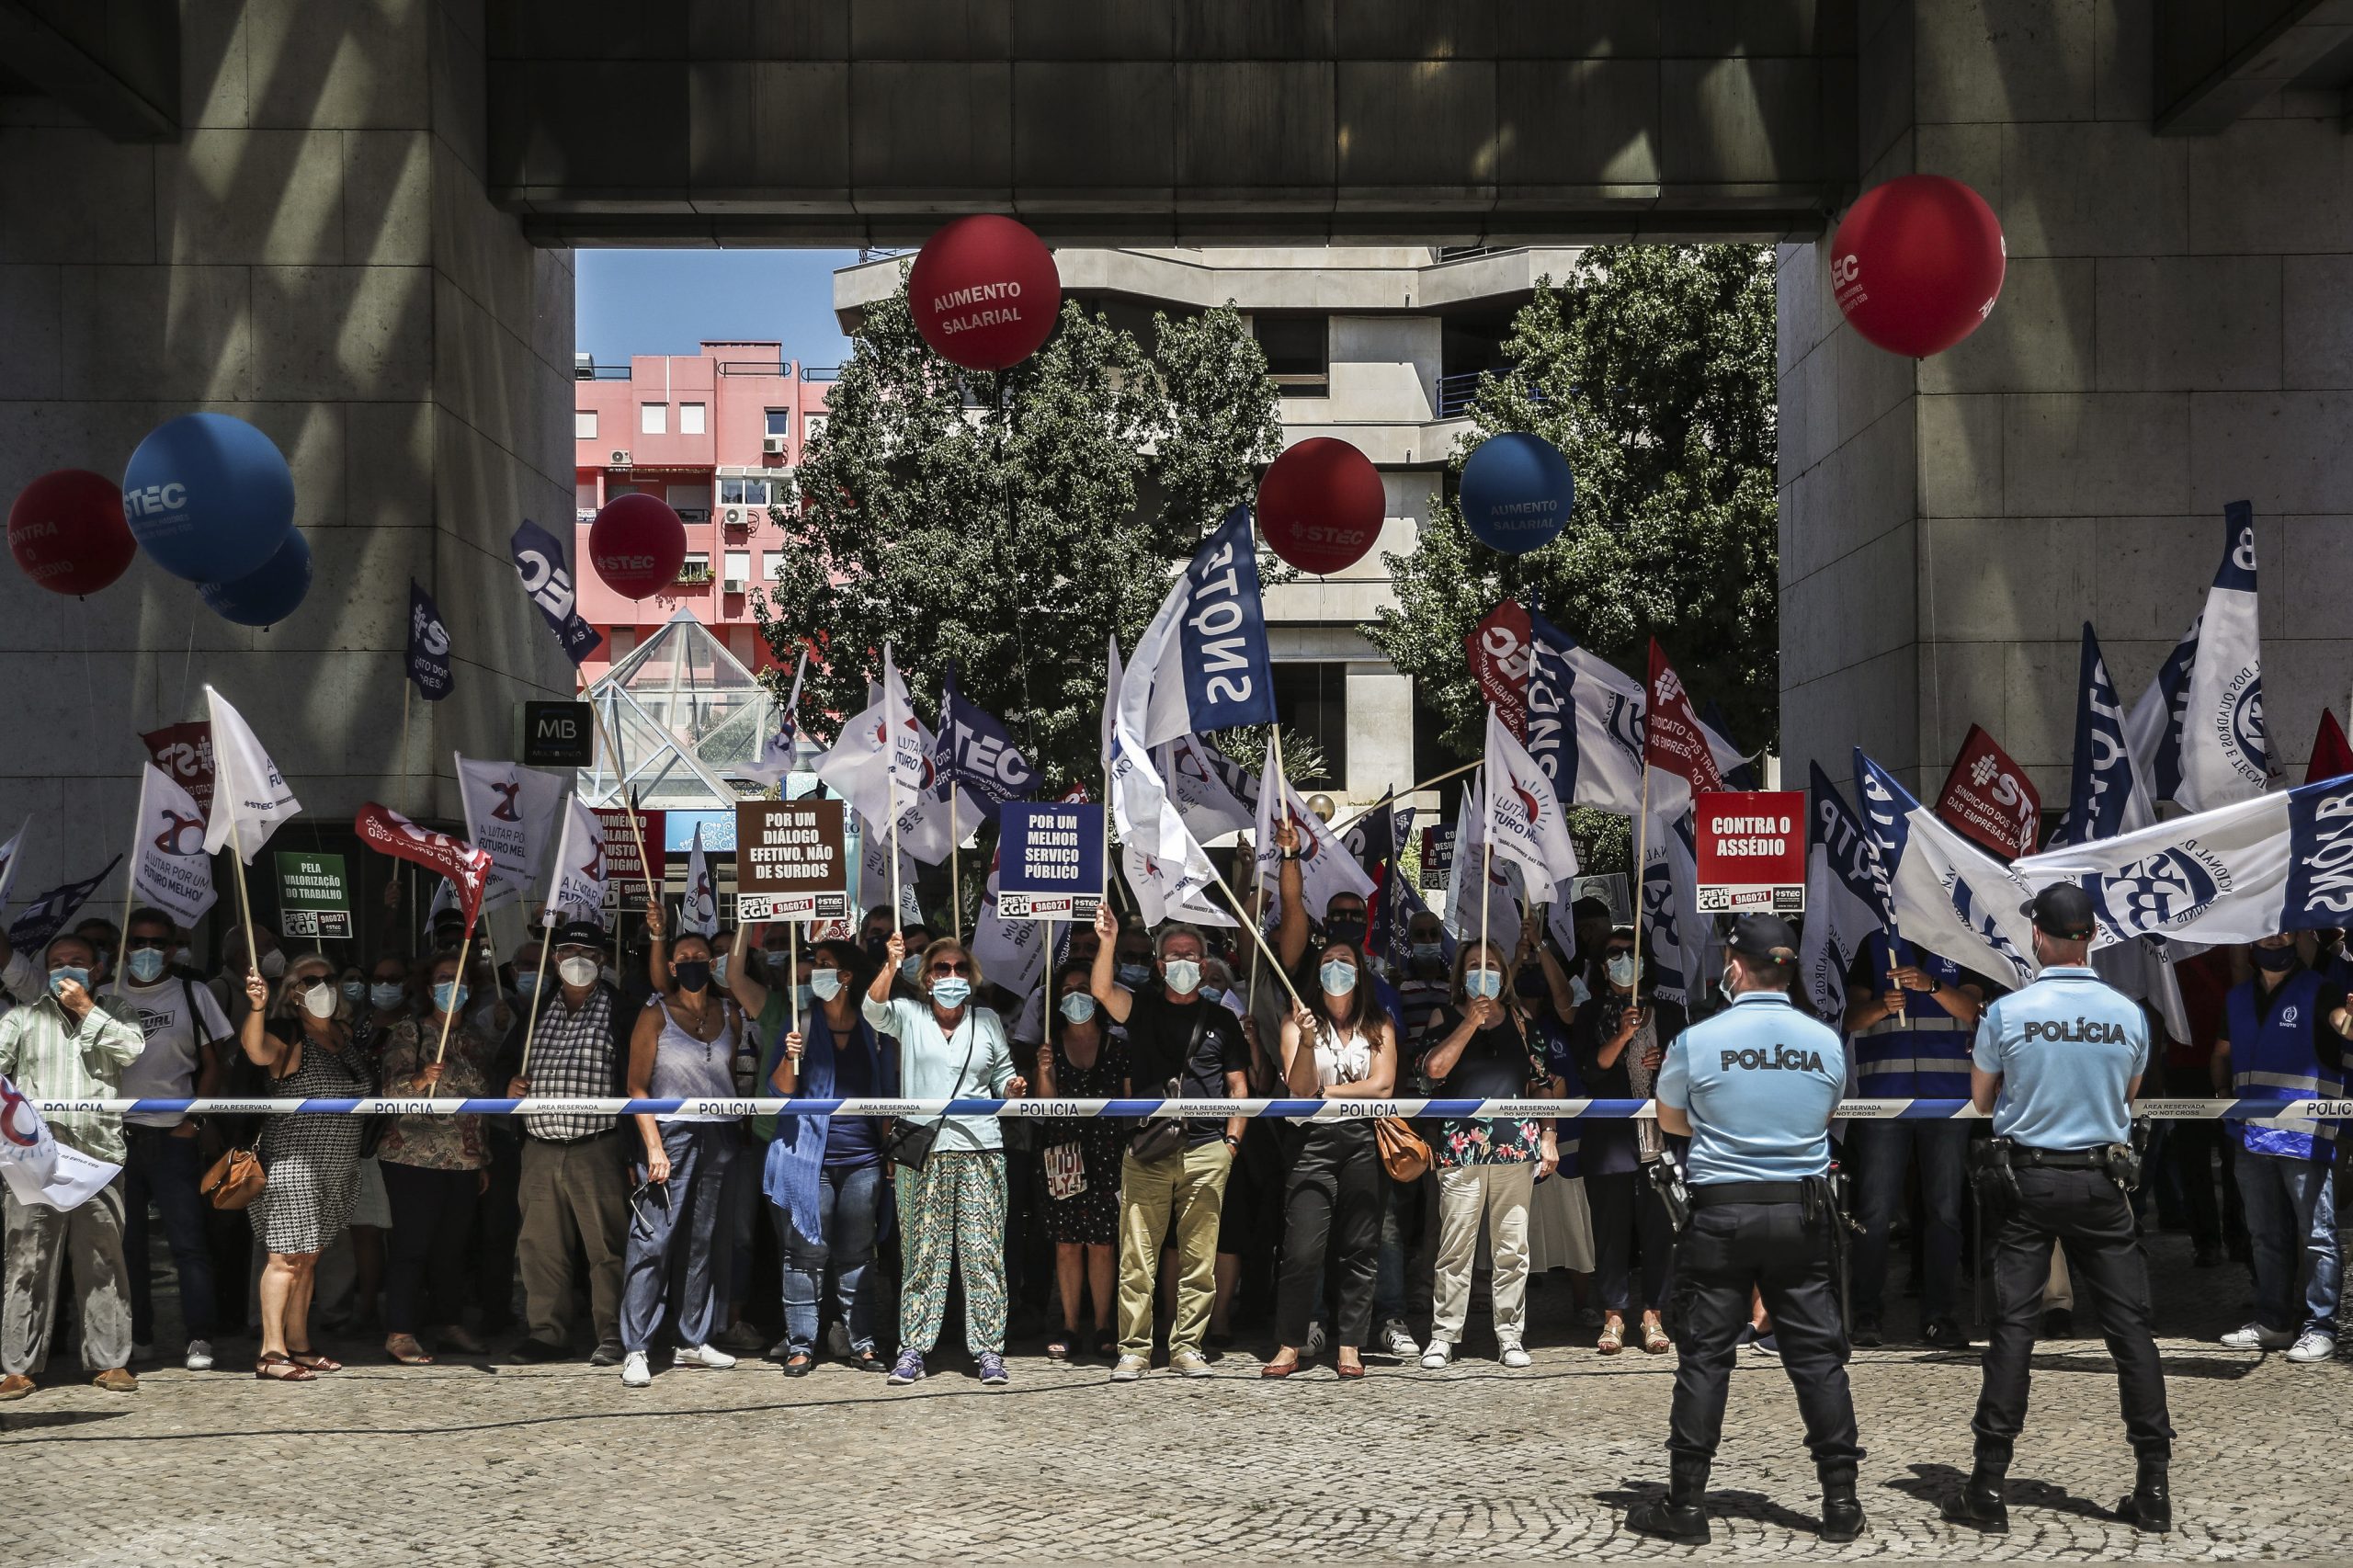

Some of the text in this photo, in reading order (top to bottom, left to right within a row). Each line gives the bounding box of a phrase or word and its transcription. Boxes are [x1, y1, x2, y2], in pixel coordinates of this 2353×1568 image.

[934, 281, 1021, 313] AUMENTO
[942, 307, 1021, 335] SALARIAL
[1491, 499, 1558, 517] AUMENTO
[1494, 517, 1555, 531] SALARIAL
[9, 521, 59, 550] ONTRA
[538, 719, 577, 739] MB
[1954, 784, 1995, 816] SINDICATO
[1995, 812, 2011, 828] DOS
[765, 812, 816, 827] POR UM
[1029, 814, 1077, 829] POR UM
[1711, 816, 1790, 835] CONTRA O
[1947, 796, 1964, 812] DAS
[1963, 809, 2006, 841] EMPRESAS
[488, 825, 512, 841] LUTAR
[763, 827, 820, 845] DIÁLOGO
[1028, 831, 1078, 846] MELHOR
[478, 837, 510, 854] FUTURO
[750, 844, 834, 862] EFETIVO, NÃO
[1716, 835, 1785, 856] ASSÉDIO
[607, 858, 641, 871] DIGNO
[1025, 847, 1079, 865] SERVIÇO
[301, 862, 322, 873] PELA
[756, 863, 829, 880] DE SURDOS
[1025, 862, 1079, 880] PÚBLICO
[172, 866, 192, 882] POR
[193, 874, 210, 890] UM
[284, 874, 341, 889] VALORIZAÇÃO
[285, 888, 342, 900] DO TRABALHO
[1699, 888, 1729, 898] GREVE
[1735, 892, 1768, 903] 9AGO21
[1699, 895, 1729, 909] CGD
[740, 896, 771, 908] GREVE
[777, 899, 809, 914] 9AGO21
[822, 897, 843, 905] STEC
[740, 904, 771, 919] CGD
[1001, 895, 1029, 904] GREVE
[1035, 901, 1067, 912] 9AGO21
[1001, 903, 1029, 915] CGD
[285, 912, 345, 924] GREVE 9AGO21
[285, 920, 317, 936] CGD
[2024, 1017, 2127, 1045] POLÍCIA
[1721, 1044, 1825, 1074] POLÍCIA
[699, 1103, 758, 1115] POLICIA
[1019, 1103, 1079, 1117] POLICIA
[1339, 1103, 1399, 1118] POLICIA
